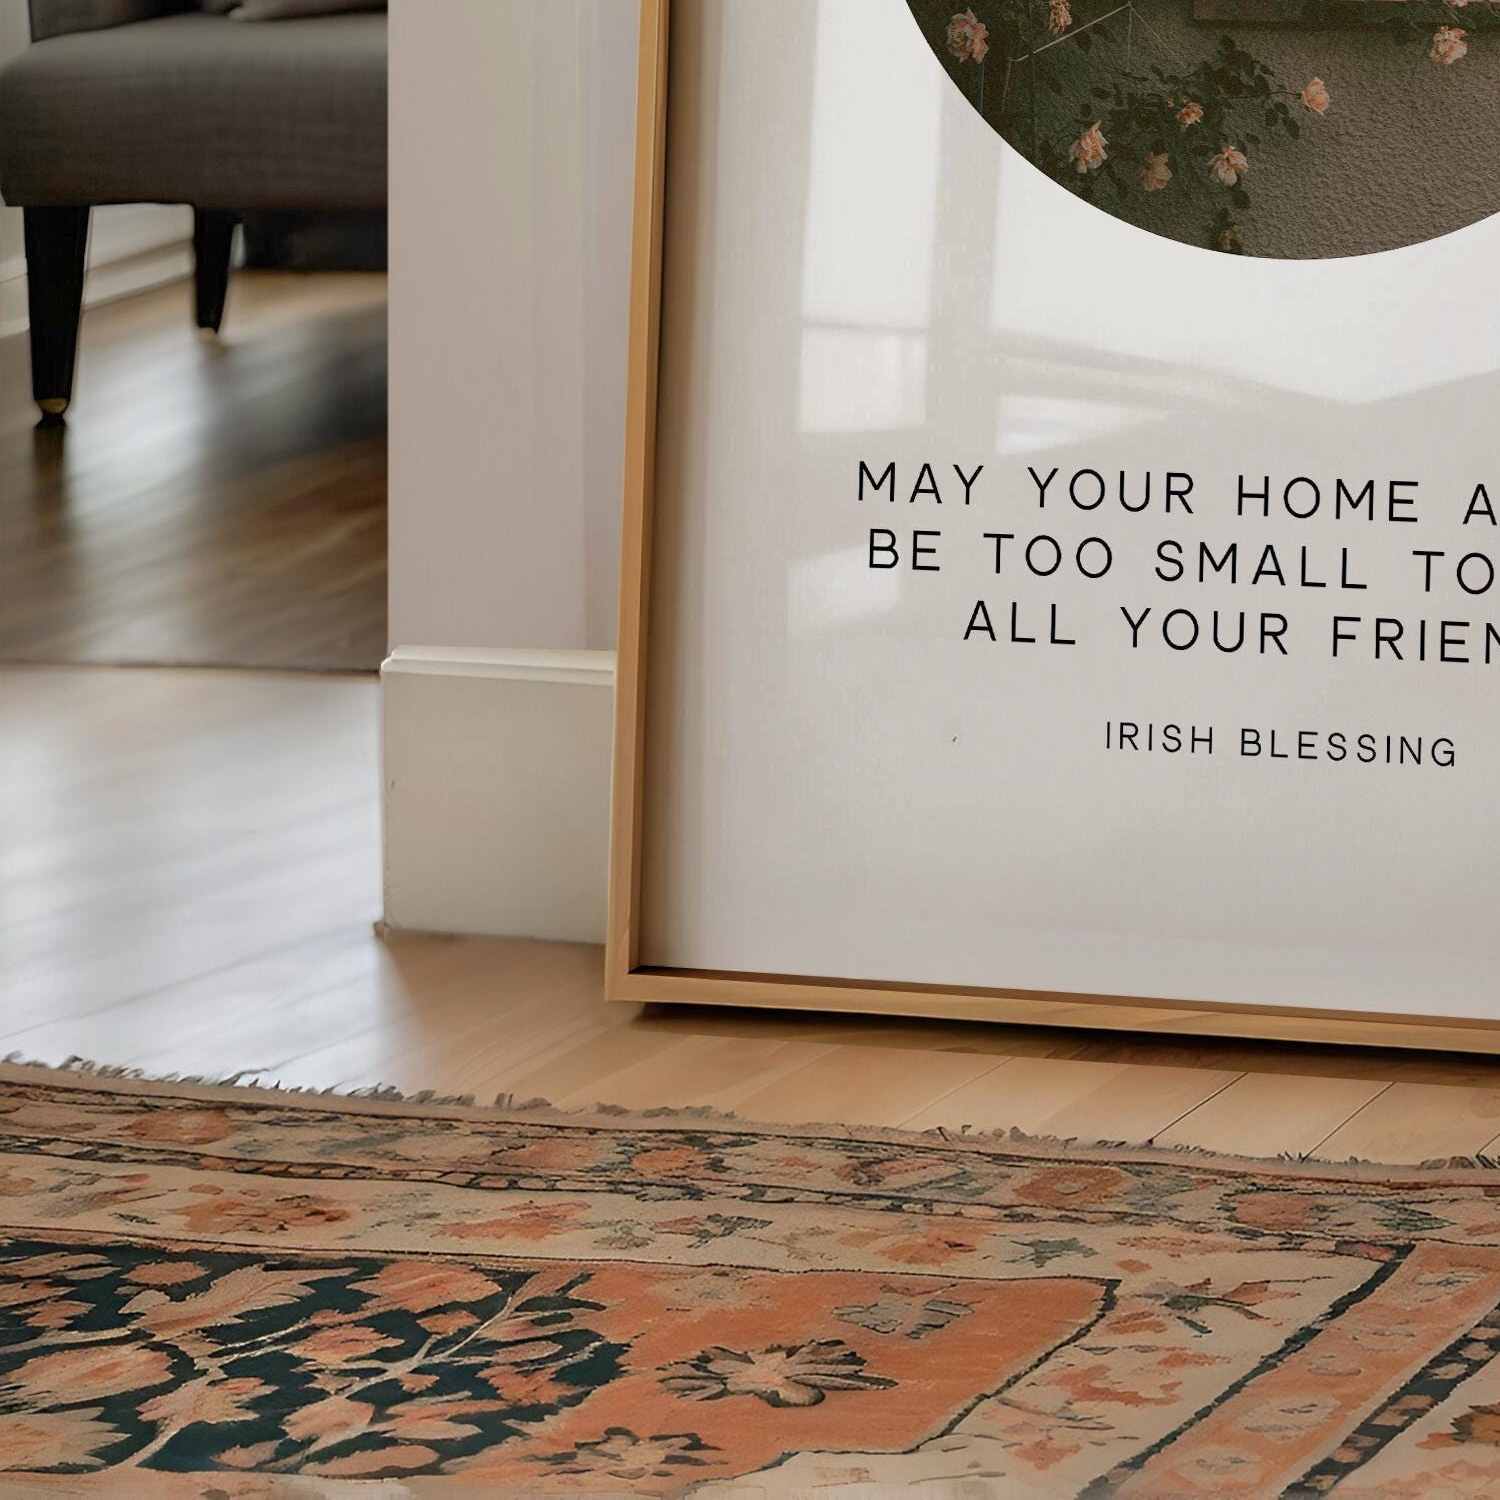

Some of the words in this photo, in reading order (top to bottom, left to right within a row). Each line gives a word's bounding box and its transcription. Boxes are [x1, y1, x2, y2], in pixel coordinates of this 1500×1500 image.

[858, 460, 985, 506] MAY
[1027, 466, 1194, 514] YOUR
[1237, 474, 1419, 523] HOME
[868, 528, 942, 572] BE
[982, 532, 1114, 579] TOO
[1154, 539, 1368, 590] SMALL
[1412, 550, 1496, 595] TO
[962, 599, 1077, 646] ALL
[1119, 606, 1290, 656] YOUR
[1105, 721, 1214, 755] IRISH
[1240, 727, 1457, 768] BLESSING
